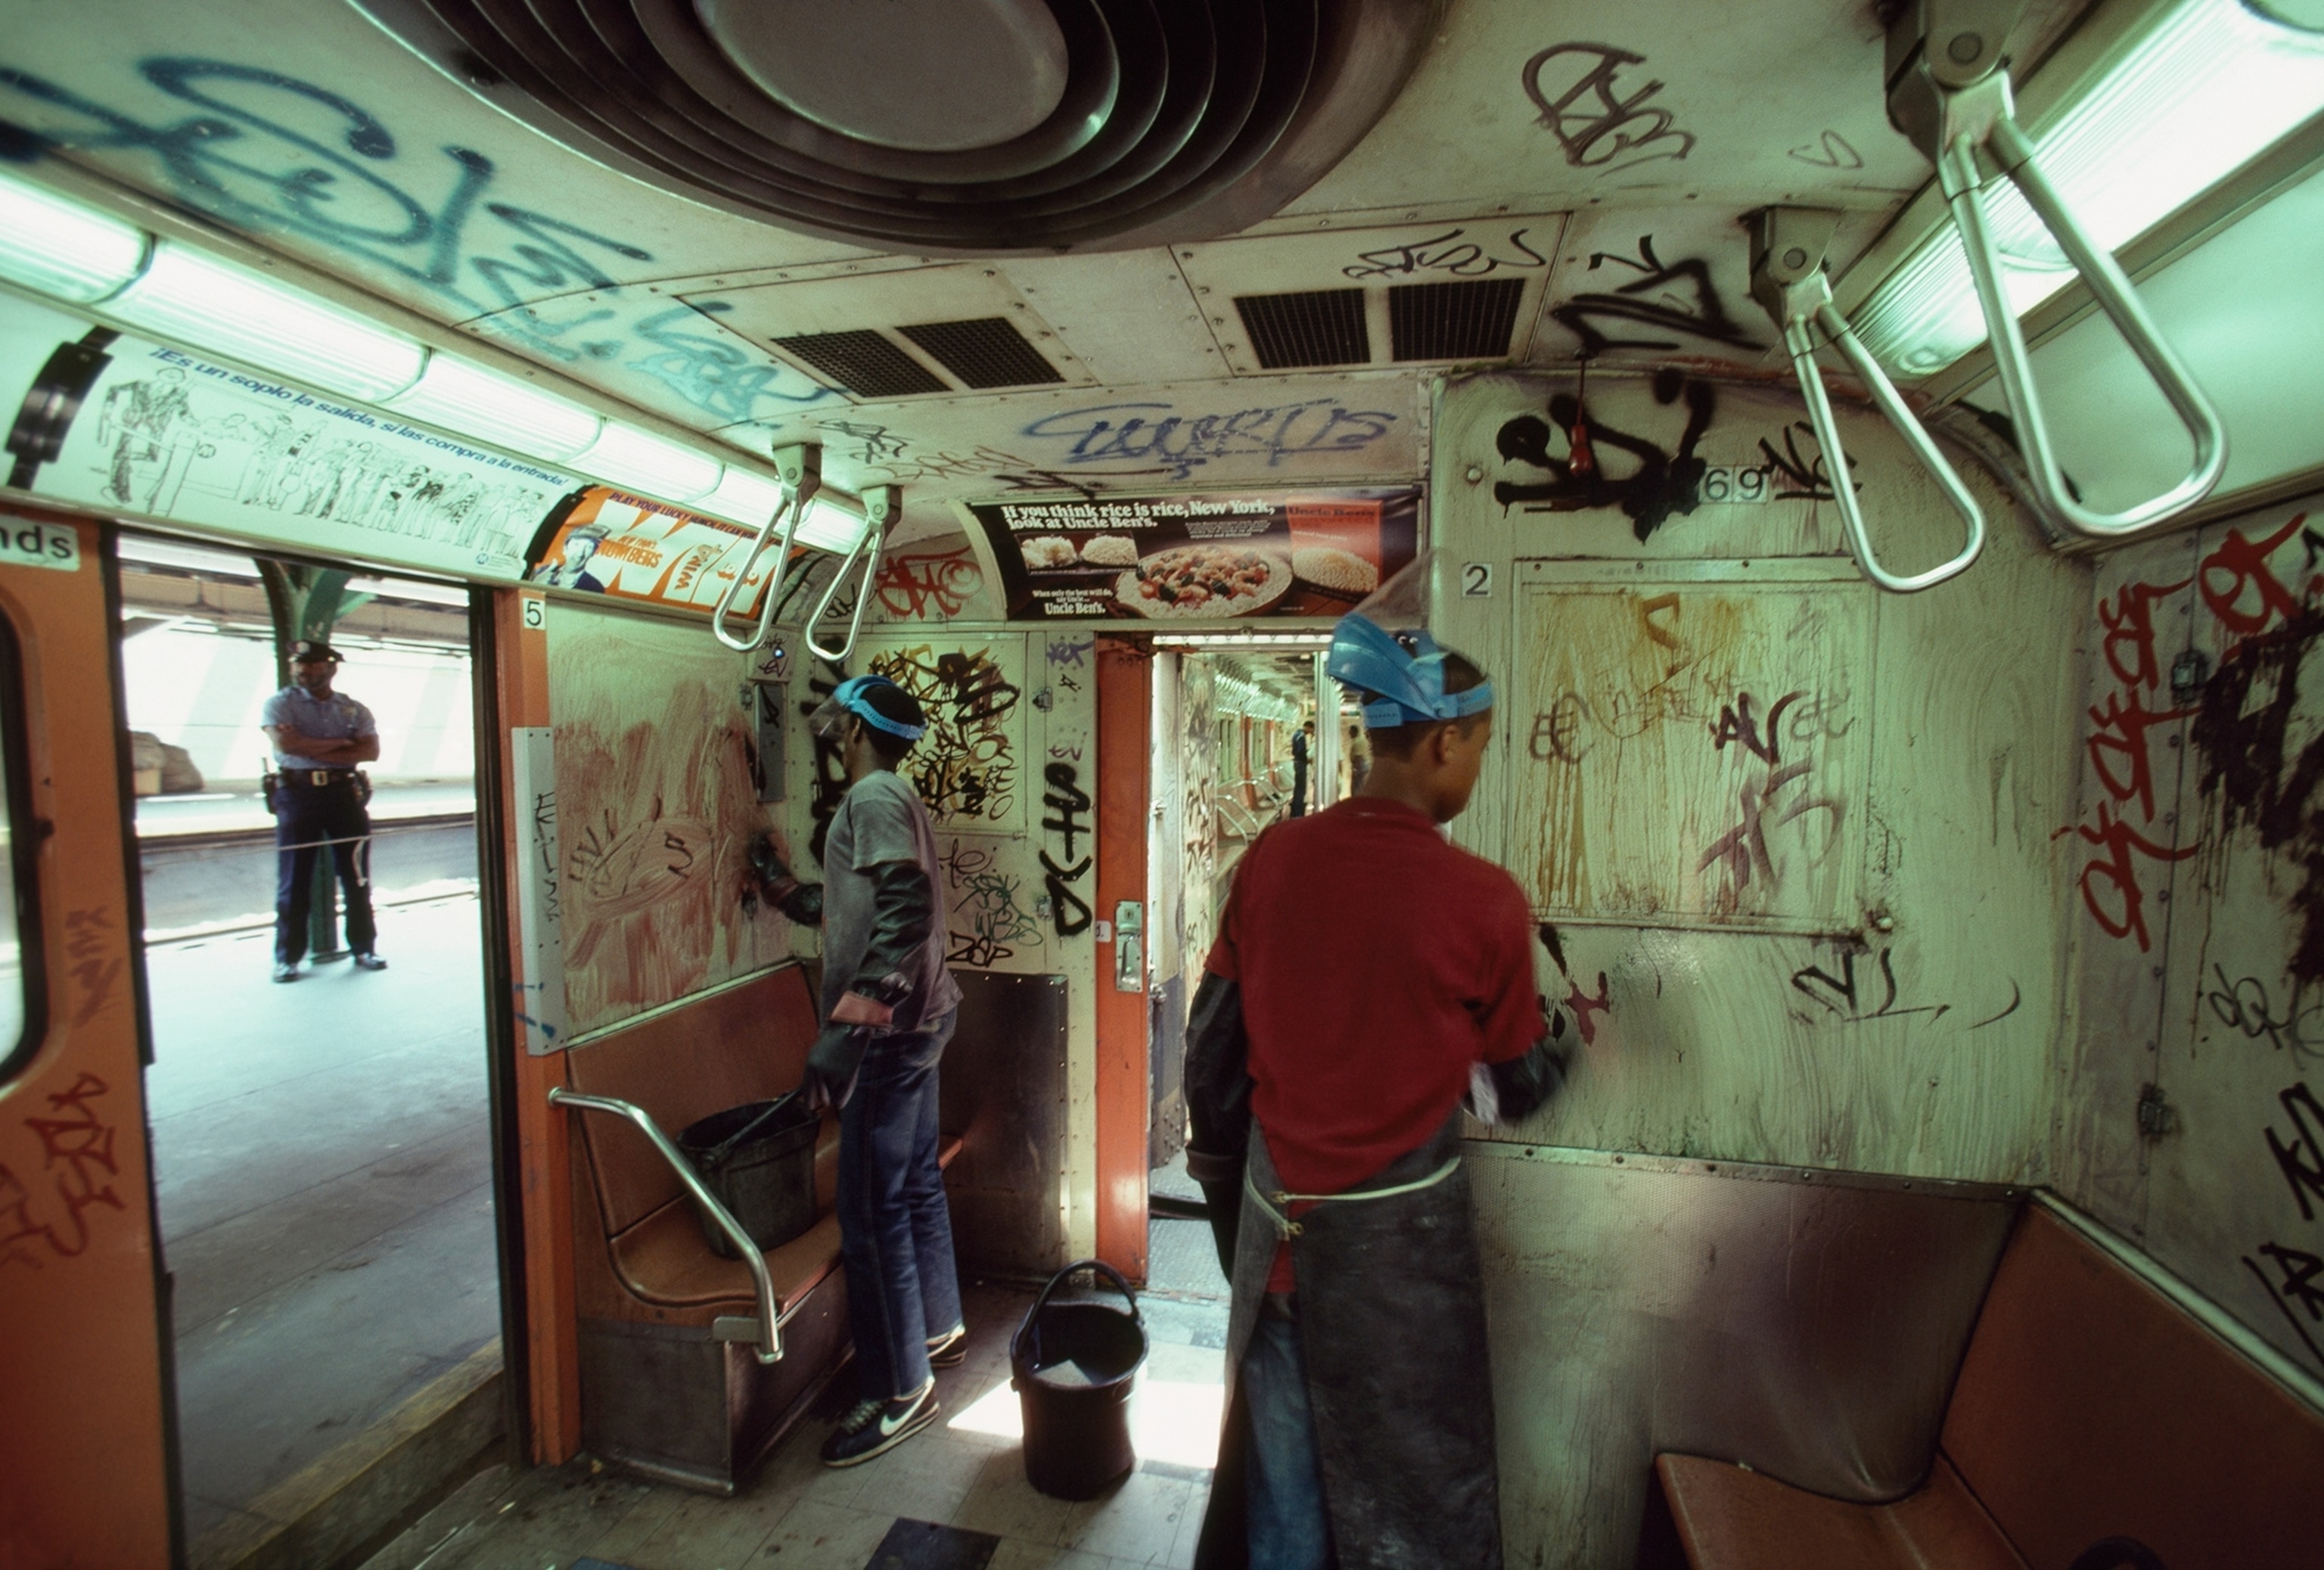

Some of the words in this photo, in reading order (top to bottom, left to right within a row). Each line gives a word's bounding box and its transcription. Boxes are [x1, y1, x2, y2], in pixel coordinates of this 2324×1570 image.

[195, 363, 228, 379] un
[229, 375, 293, 399] soplo
[294, 393, 314, 407] la
[315, 402, 376, 427] salida,
[397, 426, 425, 441] las
[425, 437, 486, 462] compra
[486, 456, 498, 465] a
[497, 459, 511, 469] la
[608, 493, 634, 506] PLAY
[635, 500, 661, 513] YOUR
[1000, 505, 1018, 520] If
[1017, 505, 1049, 520] you
[1049, 503, 1098, 518] think
[1098, 502, 1133, 518] rice
[1133, 501, 1151, 518] is
[1151, 501, 1188, 518] rice,
[1188, 500, 1228, 517] New
[1228, 498, 1275, 515] York,
[1005, 517, 1045, 530] look
[1045, 517, 1063, 530] at
[1062, 517, 1110, 530] Uncle
[1109, 516, 1158, 529] Ben's.
[1465, 565, 1489, 595] 2
[527, 601, 542, 626] 5
[1044, 602, 1074, 615] Uncle
[1075, 602, 1106, 614] Ben's.
